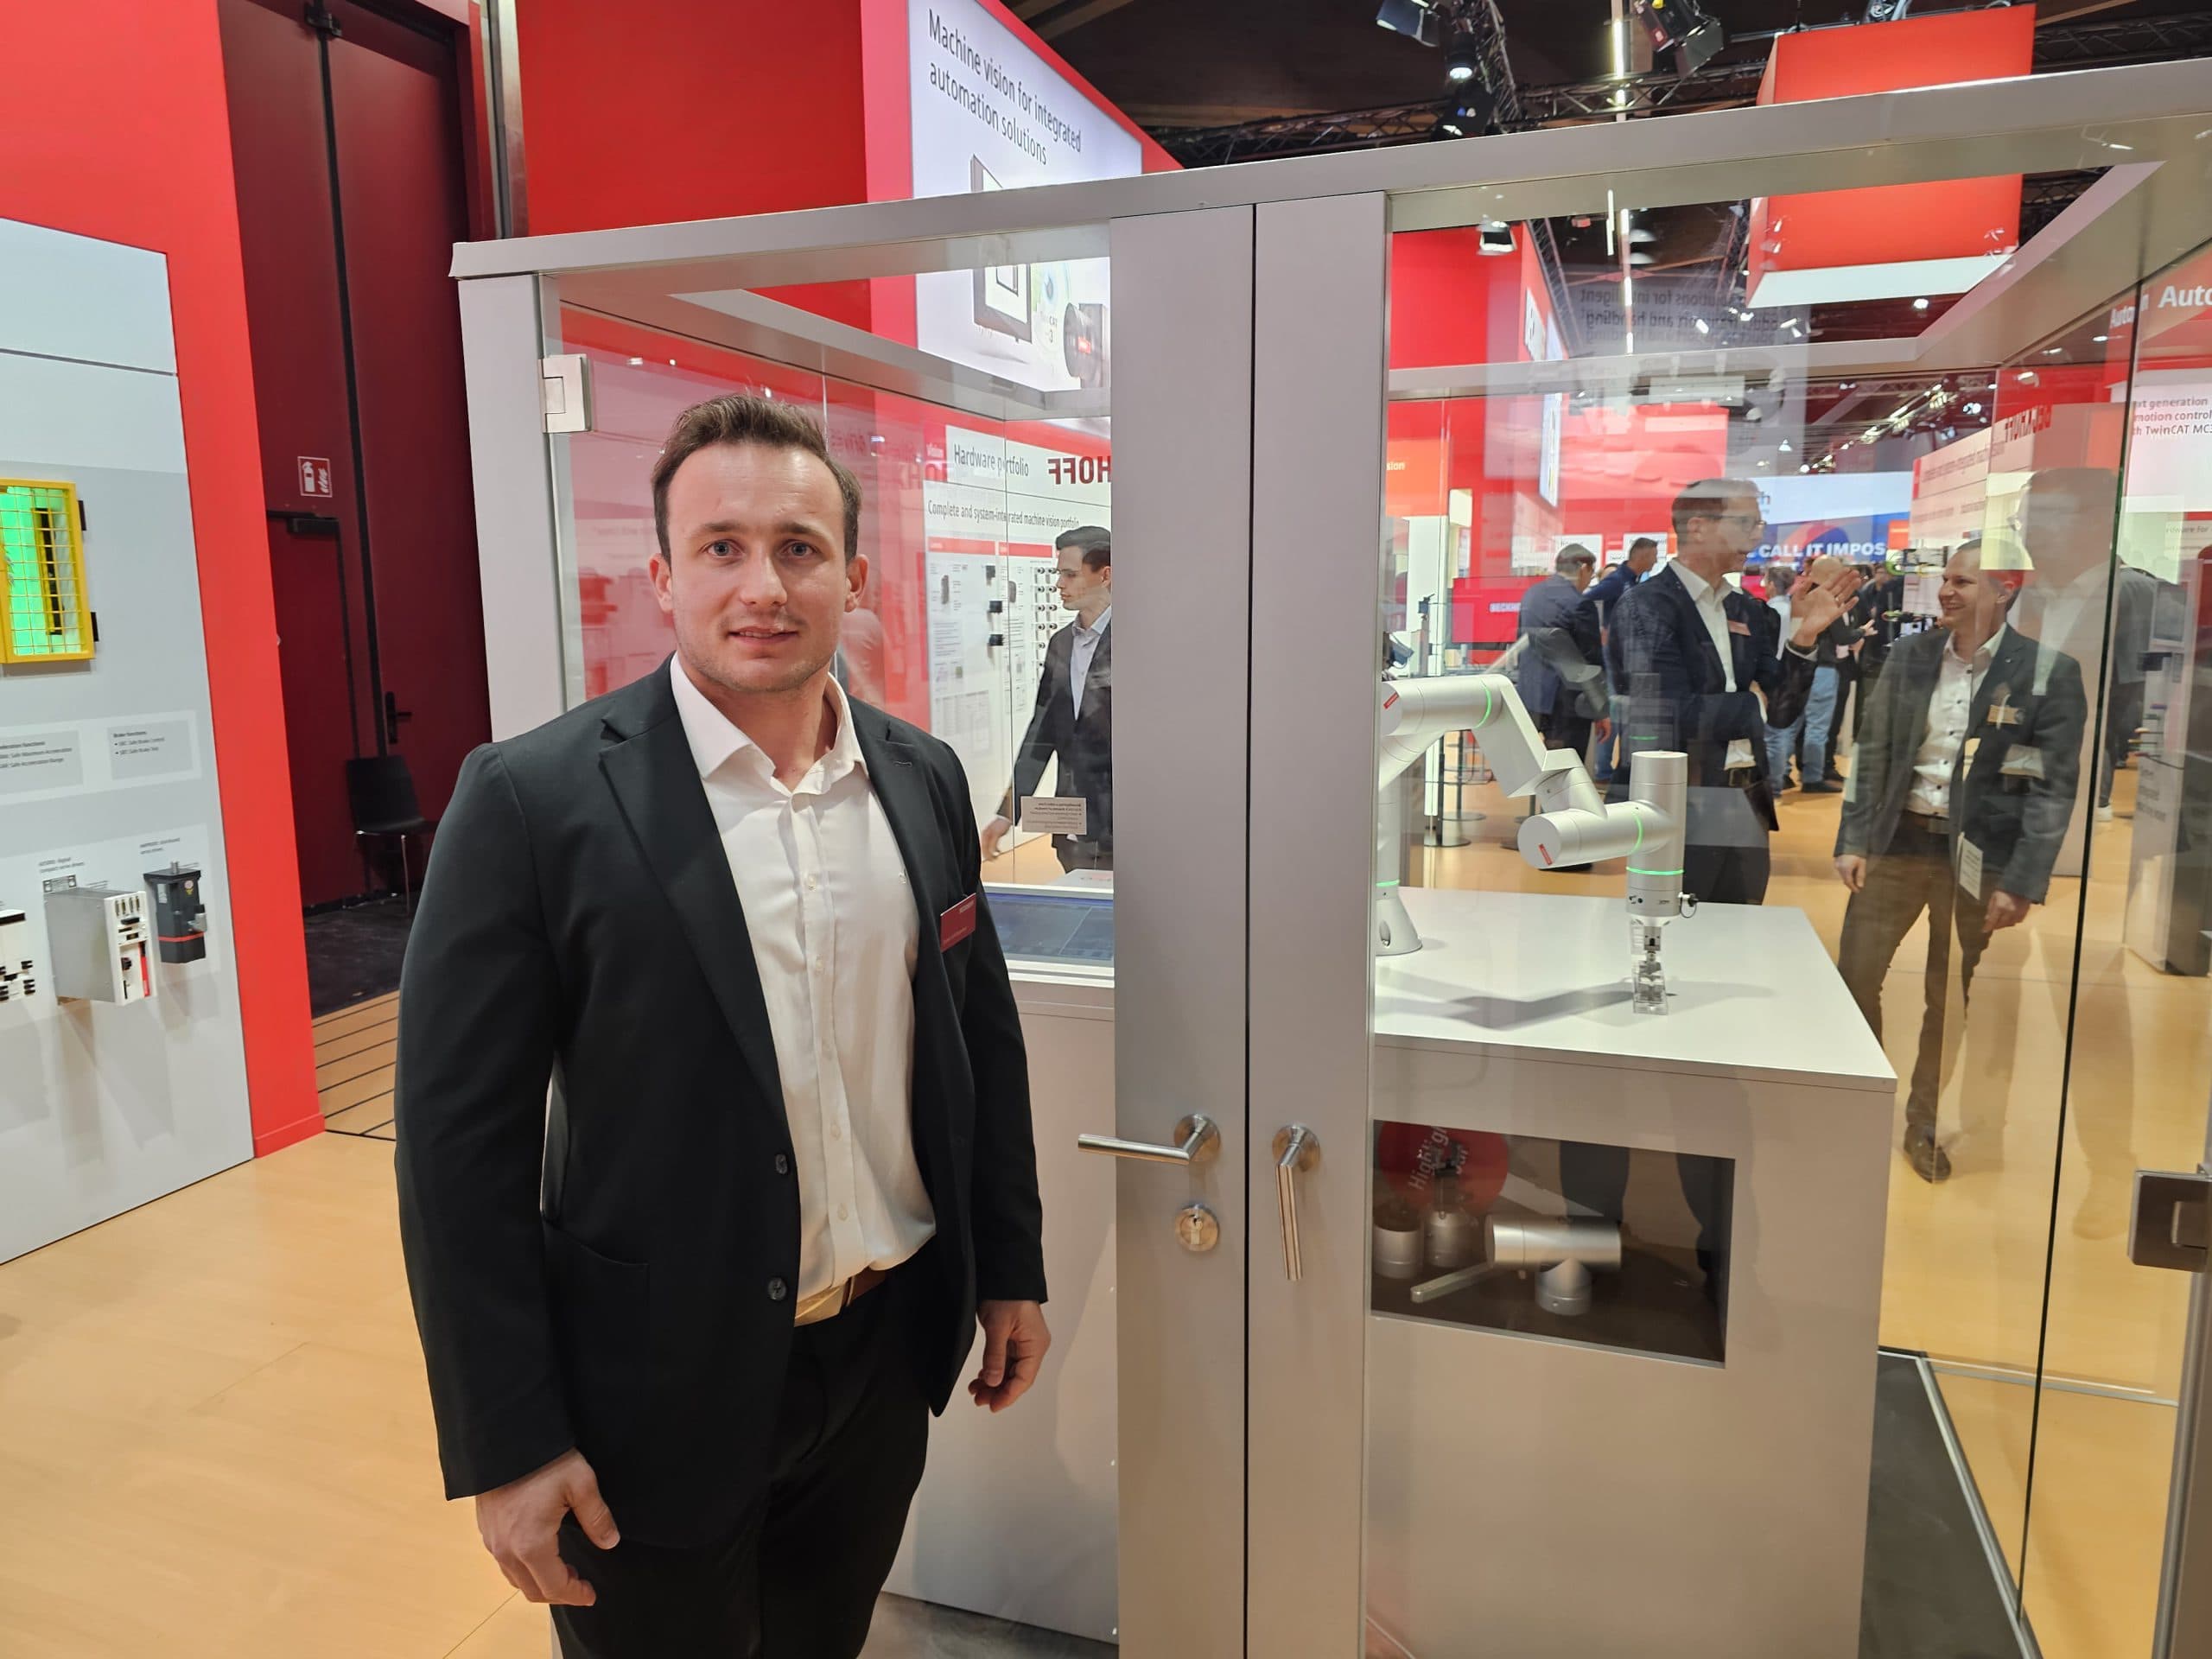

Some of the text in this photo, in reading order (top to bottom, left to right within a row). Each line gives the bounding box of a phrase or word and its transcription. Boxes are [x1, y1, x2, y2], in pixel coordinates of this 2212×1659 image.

[929, 9, 1081, 153] Machine vision for integrated
[930, 62, 1046, 165] automation solutions
[2149, 397, 2208, 410] generation
[2145, 424, 2190, 435] TwinCAT
[954, 443, 1029, 477] Hardware prtfolio
[927, 499, 960, 520] Complete
[961, 505, 972, 519] and
[1024, 512, 1045, 527] machine
[1046, 514, 1060, 528] vision
[1758, 543, 1803, 558] CALL
[1806, 543, 1825, 556] IT
[1827, 542, 1886, 556] IMPOS
